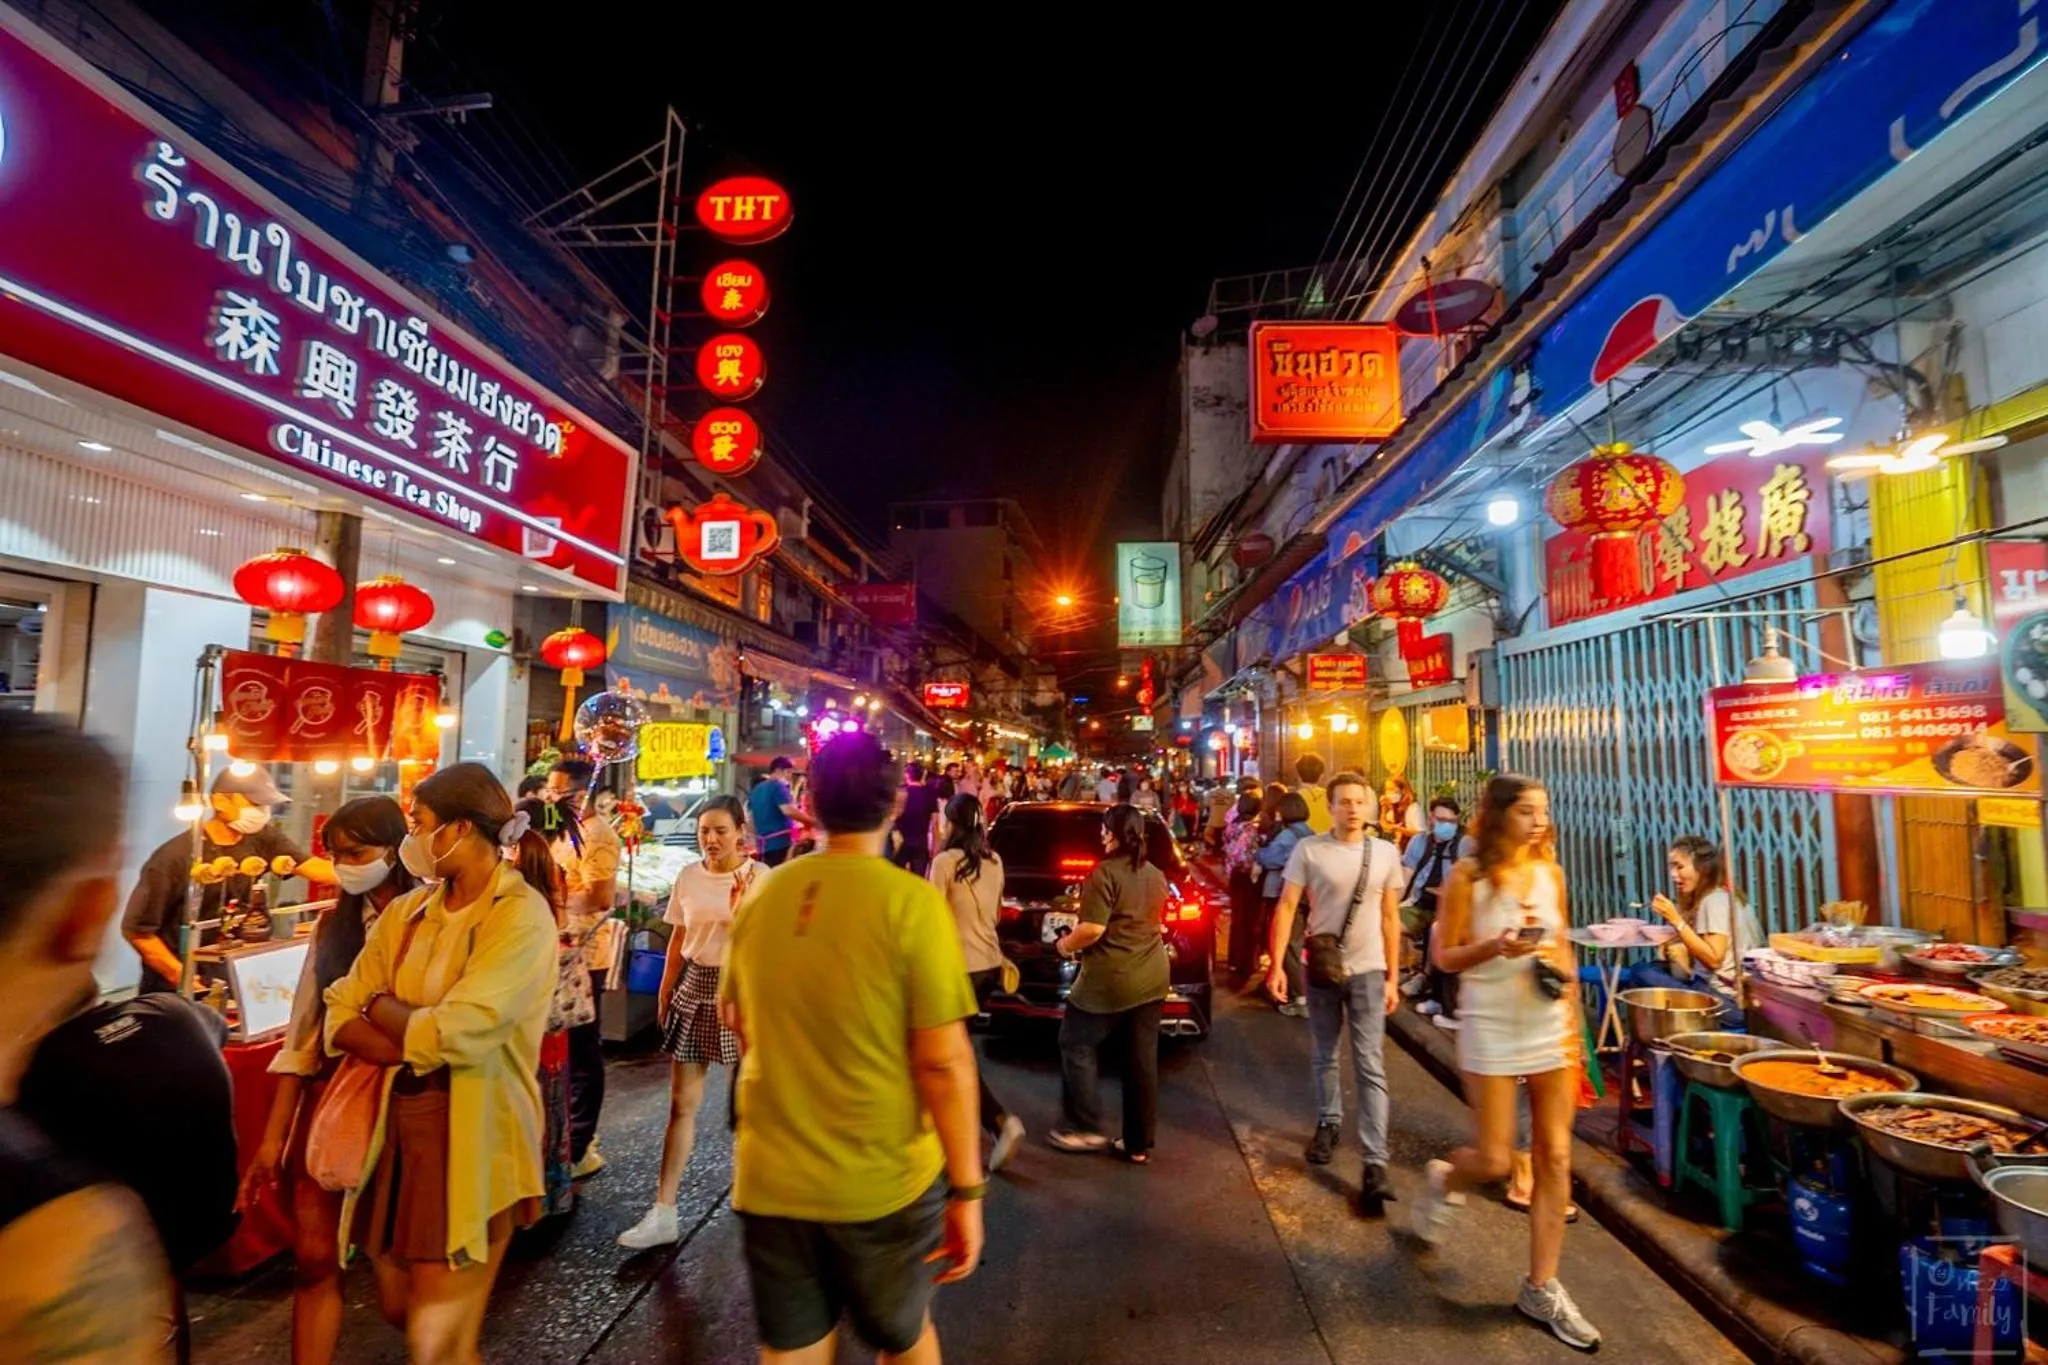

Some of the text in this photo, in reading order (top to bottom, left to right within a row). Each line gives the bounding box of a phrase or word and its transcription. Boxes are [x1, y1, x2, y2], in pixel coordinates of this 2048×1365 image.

[709, 195, 780, 221] THT
[215, 290, 519, 493] 森興發茶行
[276, 423, 483, 533] Chinese Tea Shop
